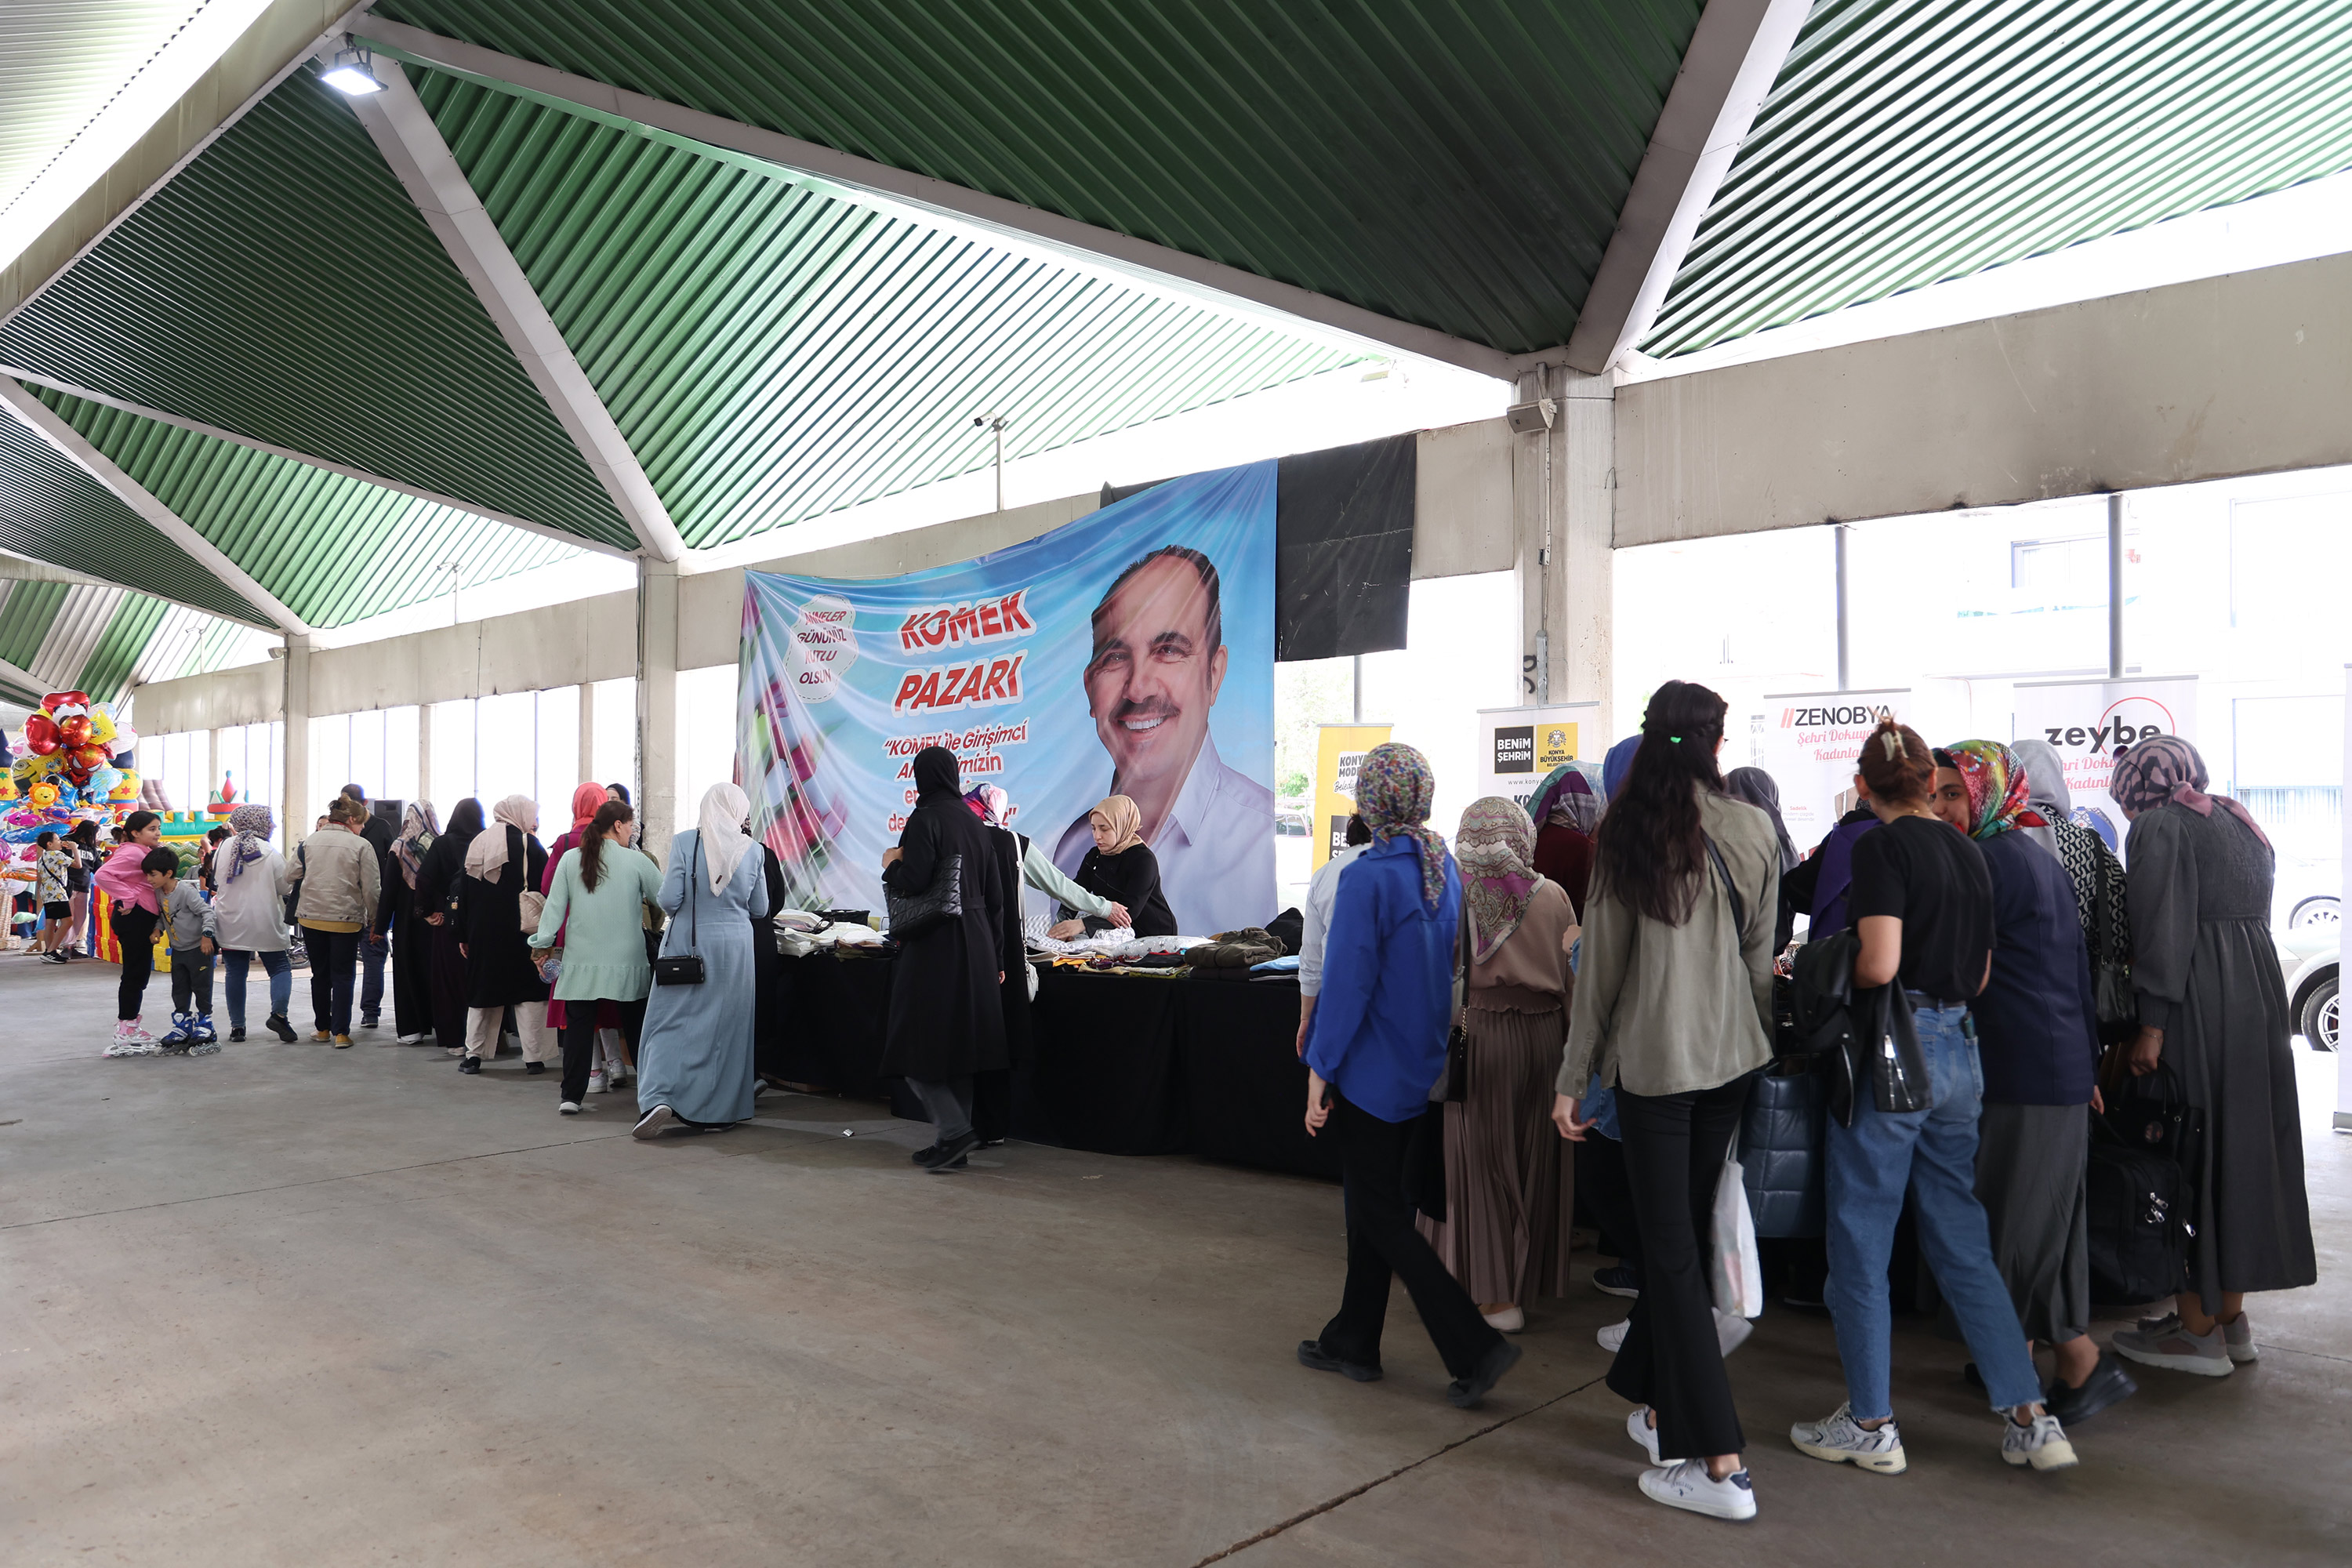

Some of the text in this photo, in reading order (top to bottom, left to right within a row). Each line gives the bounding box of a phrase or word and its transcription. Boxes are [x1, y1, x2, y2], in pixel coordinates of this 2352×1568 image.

[804, 611, 847, 625] ANNELER
[902, 590, 1032, 650] KOMEK
[797, 626, 847, 644] GÜNÜNÜZ
[804, 649, 838, 664] KUTLU
[799, 669, 832, 684] OLSUN
[895, 655, 1023, 712] PAZARI
[1795, 705, 1893, 726] ZENOBYA
[963, 720, 1028, 750] Girişimci
[1797, 728, 1875, 747] Şehri Dokuya
[1540, 754, 1573, 763] BÜYÜKŞEHİR
[1813, 746, 1861, 761] Kadınla
[2082, 756, 2118, 770] Doku
[2064, 775, 2112, 790] Kadınl
